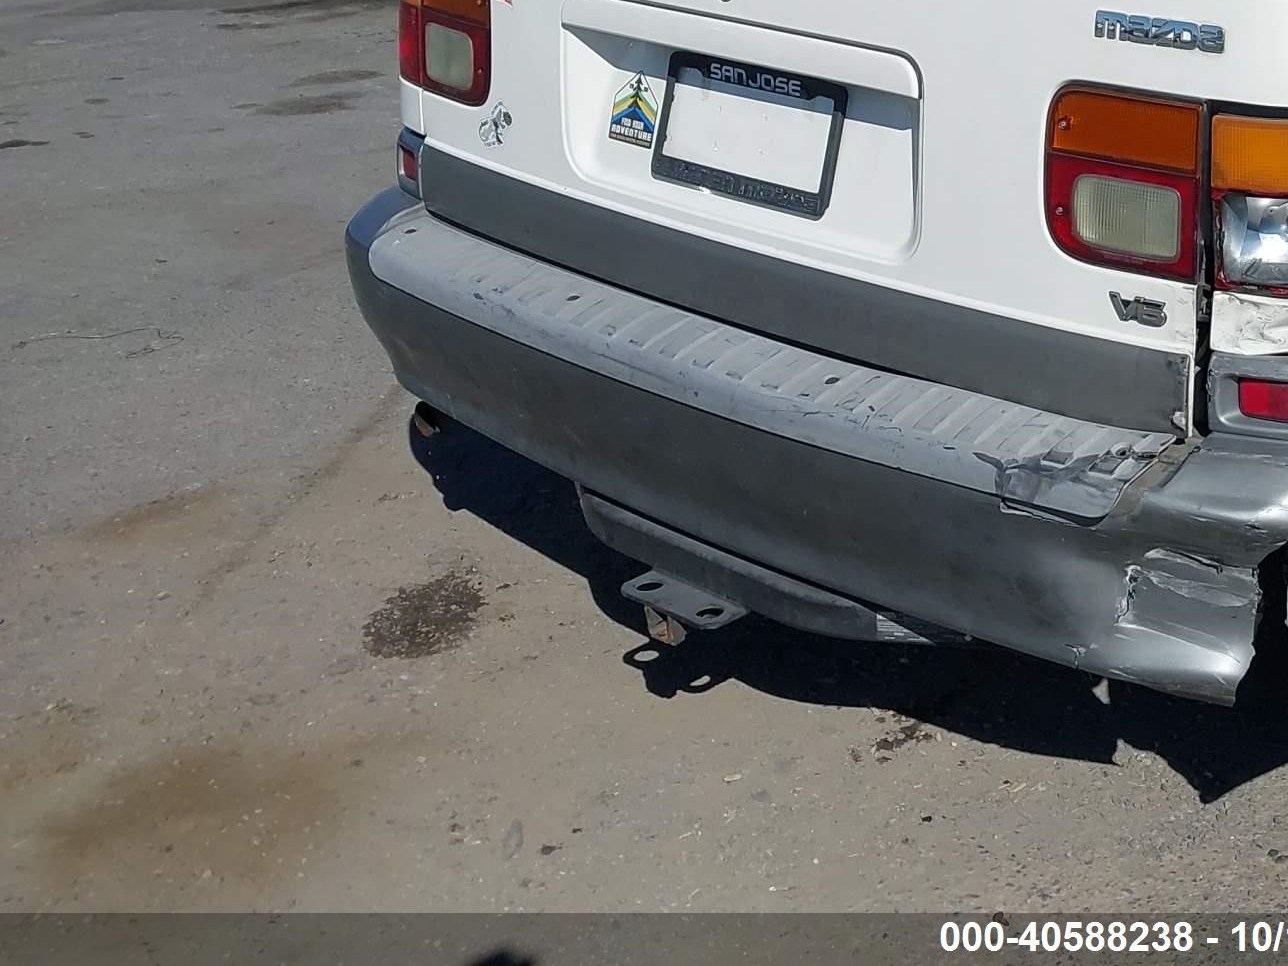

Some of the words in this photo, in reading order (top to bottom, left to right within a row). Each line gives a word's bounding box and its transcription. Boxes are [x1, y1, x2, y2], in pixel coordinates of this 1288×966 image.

[710, 63, 747, 85] SAN
[749, 72, 801, 97] JOSE
[1108, 290, 1168, 328] V6
